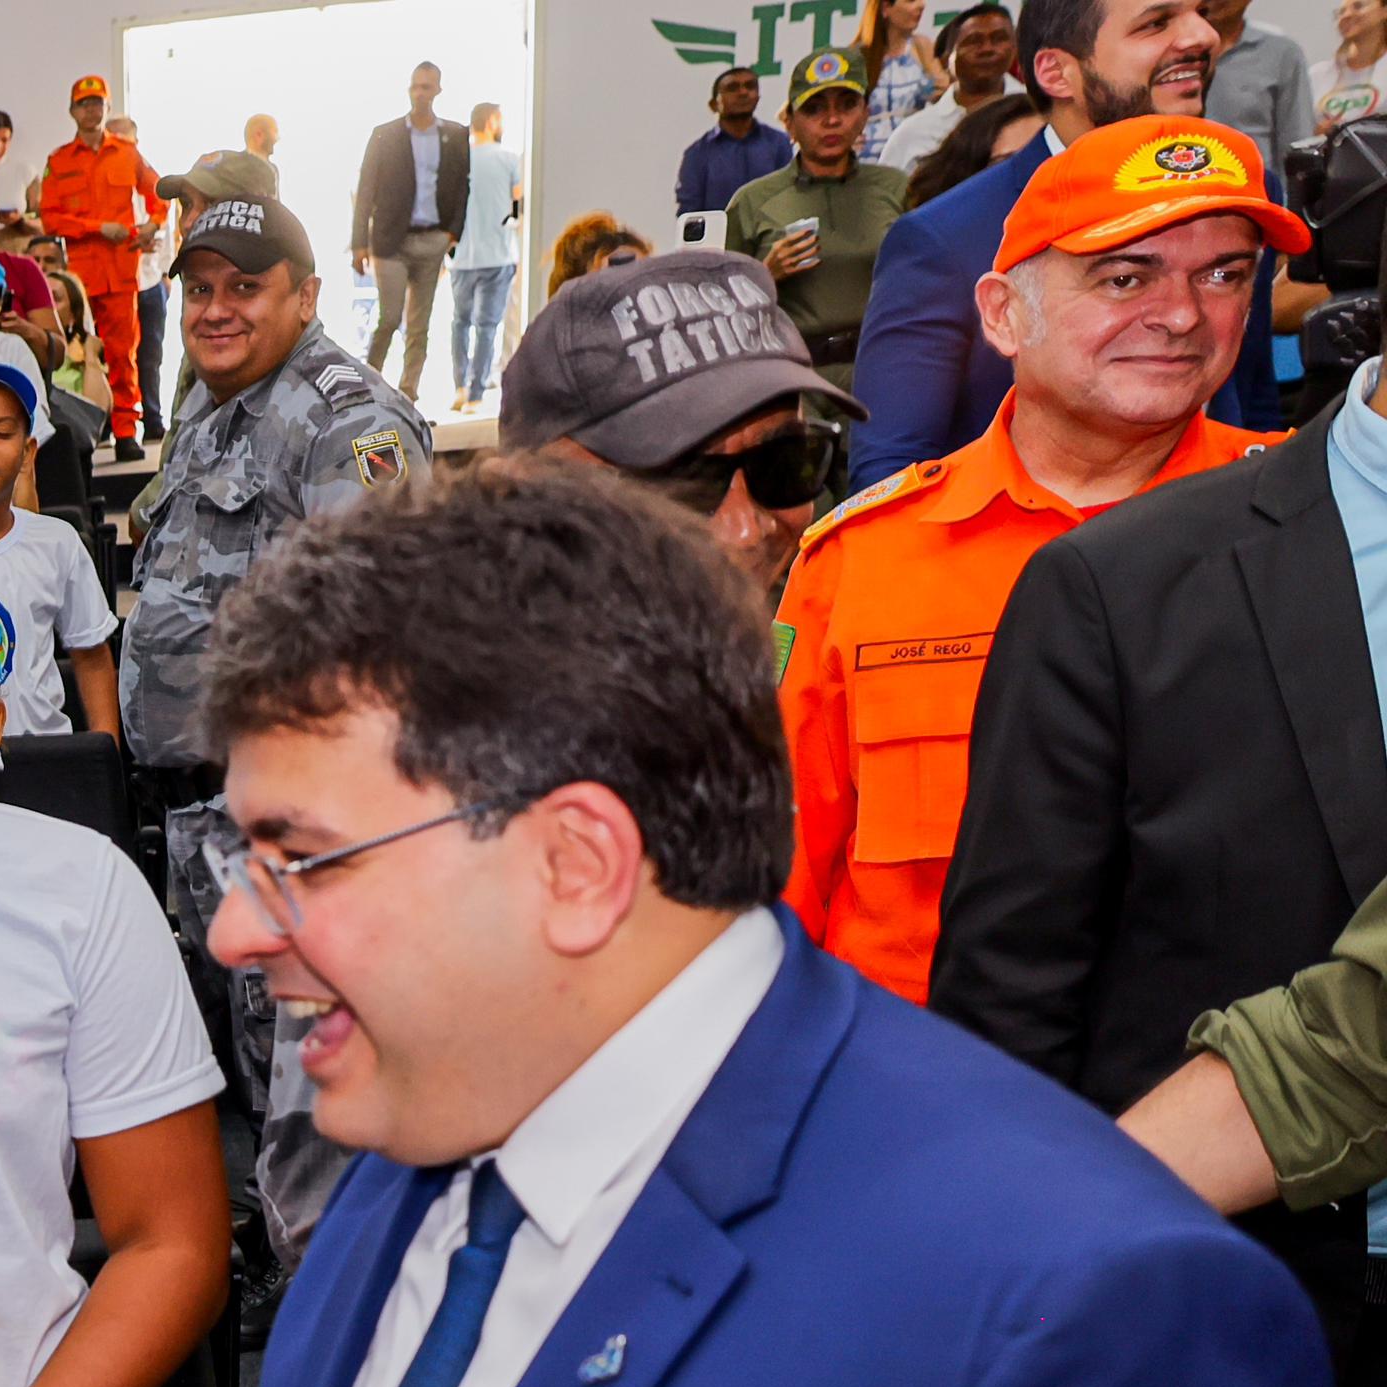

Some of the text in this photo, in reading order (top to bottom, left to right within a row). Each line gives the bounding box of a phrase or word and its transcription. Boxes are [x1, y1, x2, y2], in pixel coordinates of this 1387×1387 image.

[611, 274, 772, 341] FORÇA
[890, 641, 972, 659] JOSÉ REGO
